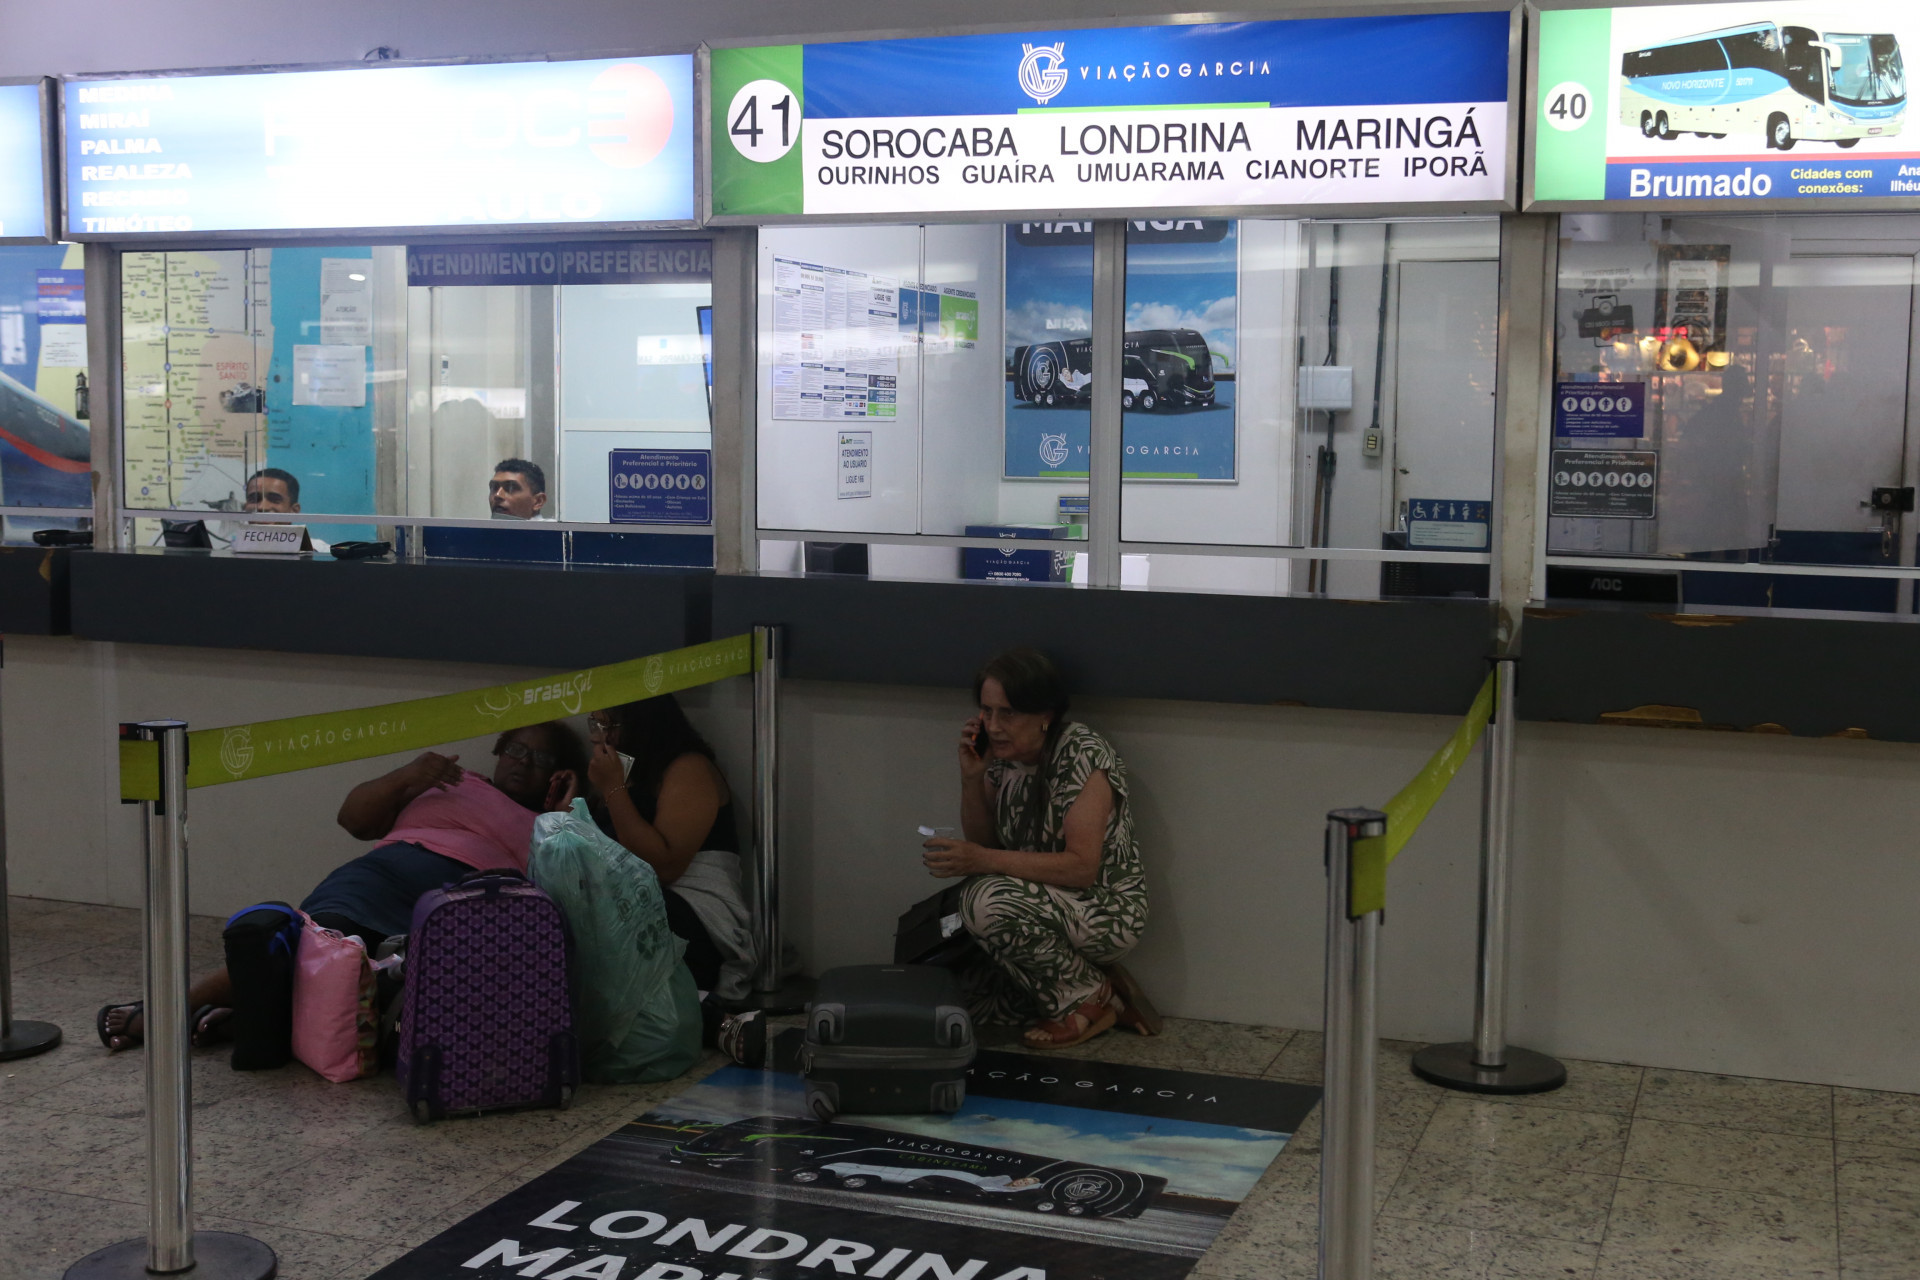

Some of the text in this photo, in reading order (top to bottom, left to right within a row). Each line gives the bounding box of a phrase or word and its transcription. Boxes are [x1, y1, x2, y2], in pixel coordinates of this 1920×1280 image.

[1080, 60, 1271, 82] VIAÇÃO GARCIA
[1662, 81, 1680, 90] NOVO
[1682, 78, 1725, 89] HORIZONTE
[1549, 93, 1588, 120] 40
[80, 109, 150, 129] MIRAÍ
[730, 94, 792, 148] 41
[822, 107, 1481, 160] SOROCABA LONDRINA MARINGÁ
[81, 138, 162, 154] PALMA
[82, 163, 192, 181] REALEZA
[817, 150, 1488, 186] OURINHOS GUAÍRA UMUARAMA CIANORTE IPORÃ
[1790, 168, 1873, 180] Cidades com
[1629, 168, 1772, 198] Brumado
[1798, 180, 1864, 194] conexões:
[83, 212, 193, 232] TIMÓTEO
[408, 251, 556, 276] ATENDIMENTO
[1584, 278, 1628, 294] ZAP
[841, 448, 869, 457] ATENDIMENTO
[1140, 446, 1199, 456] GARCIA
[244, 531, 297, 543] FECHADO
[1590, 578, 1622, 592] AOC
[715, 648, 748, 665] GARCI
[265, 720, 407, 752] VIAÇÃO GARCIA
[966, 1068, 1217, 1103] AÇÃO GARCIA
[887, 1137, 1022, 1165] VIAÇÃO GARCIA
